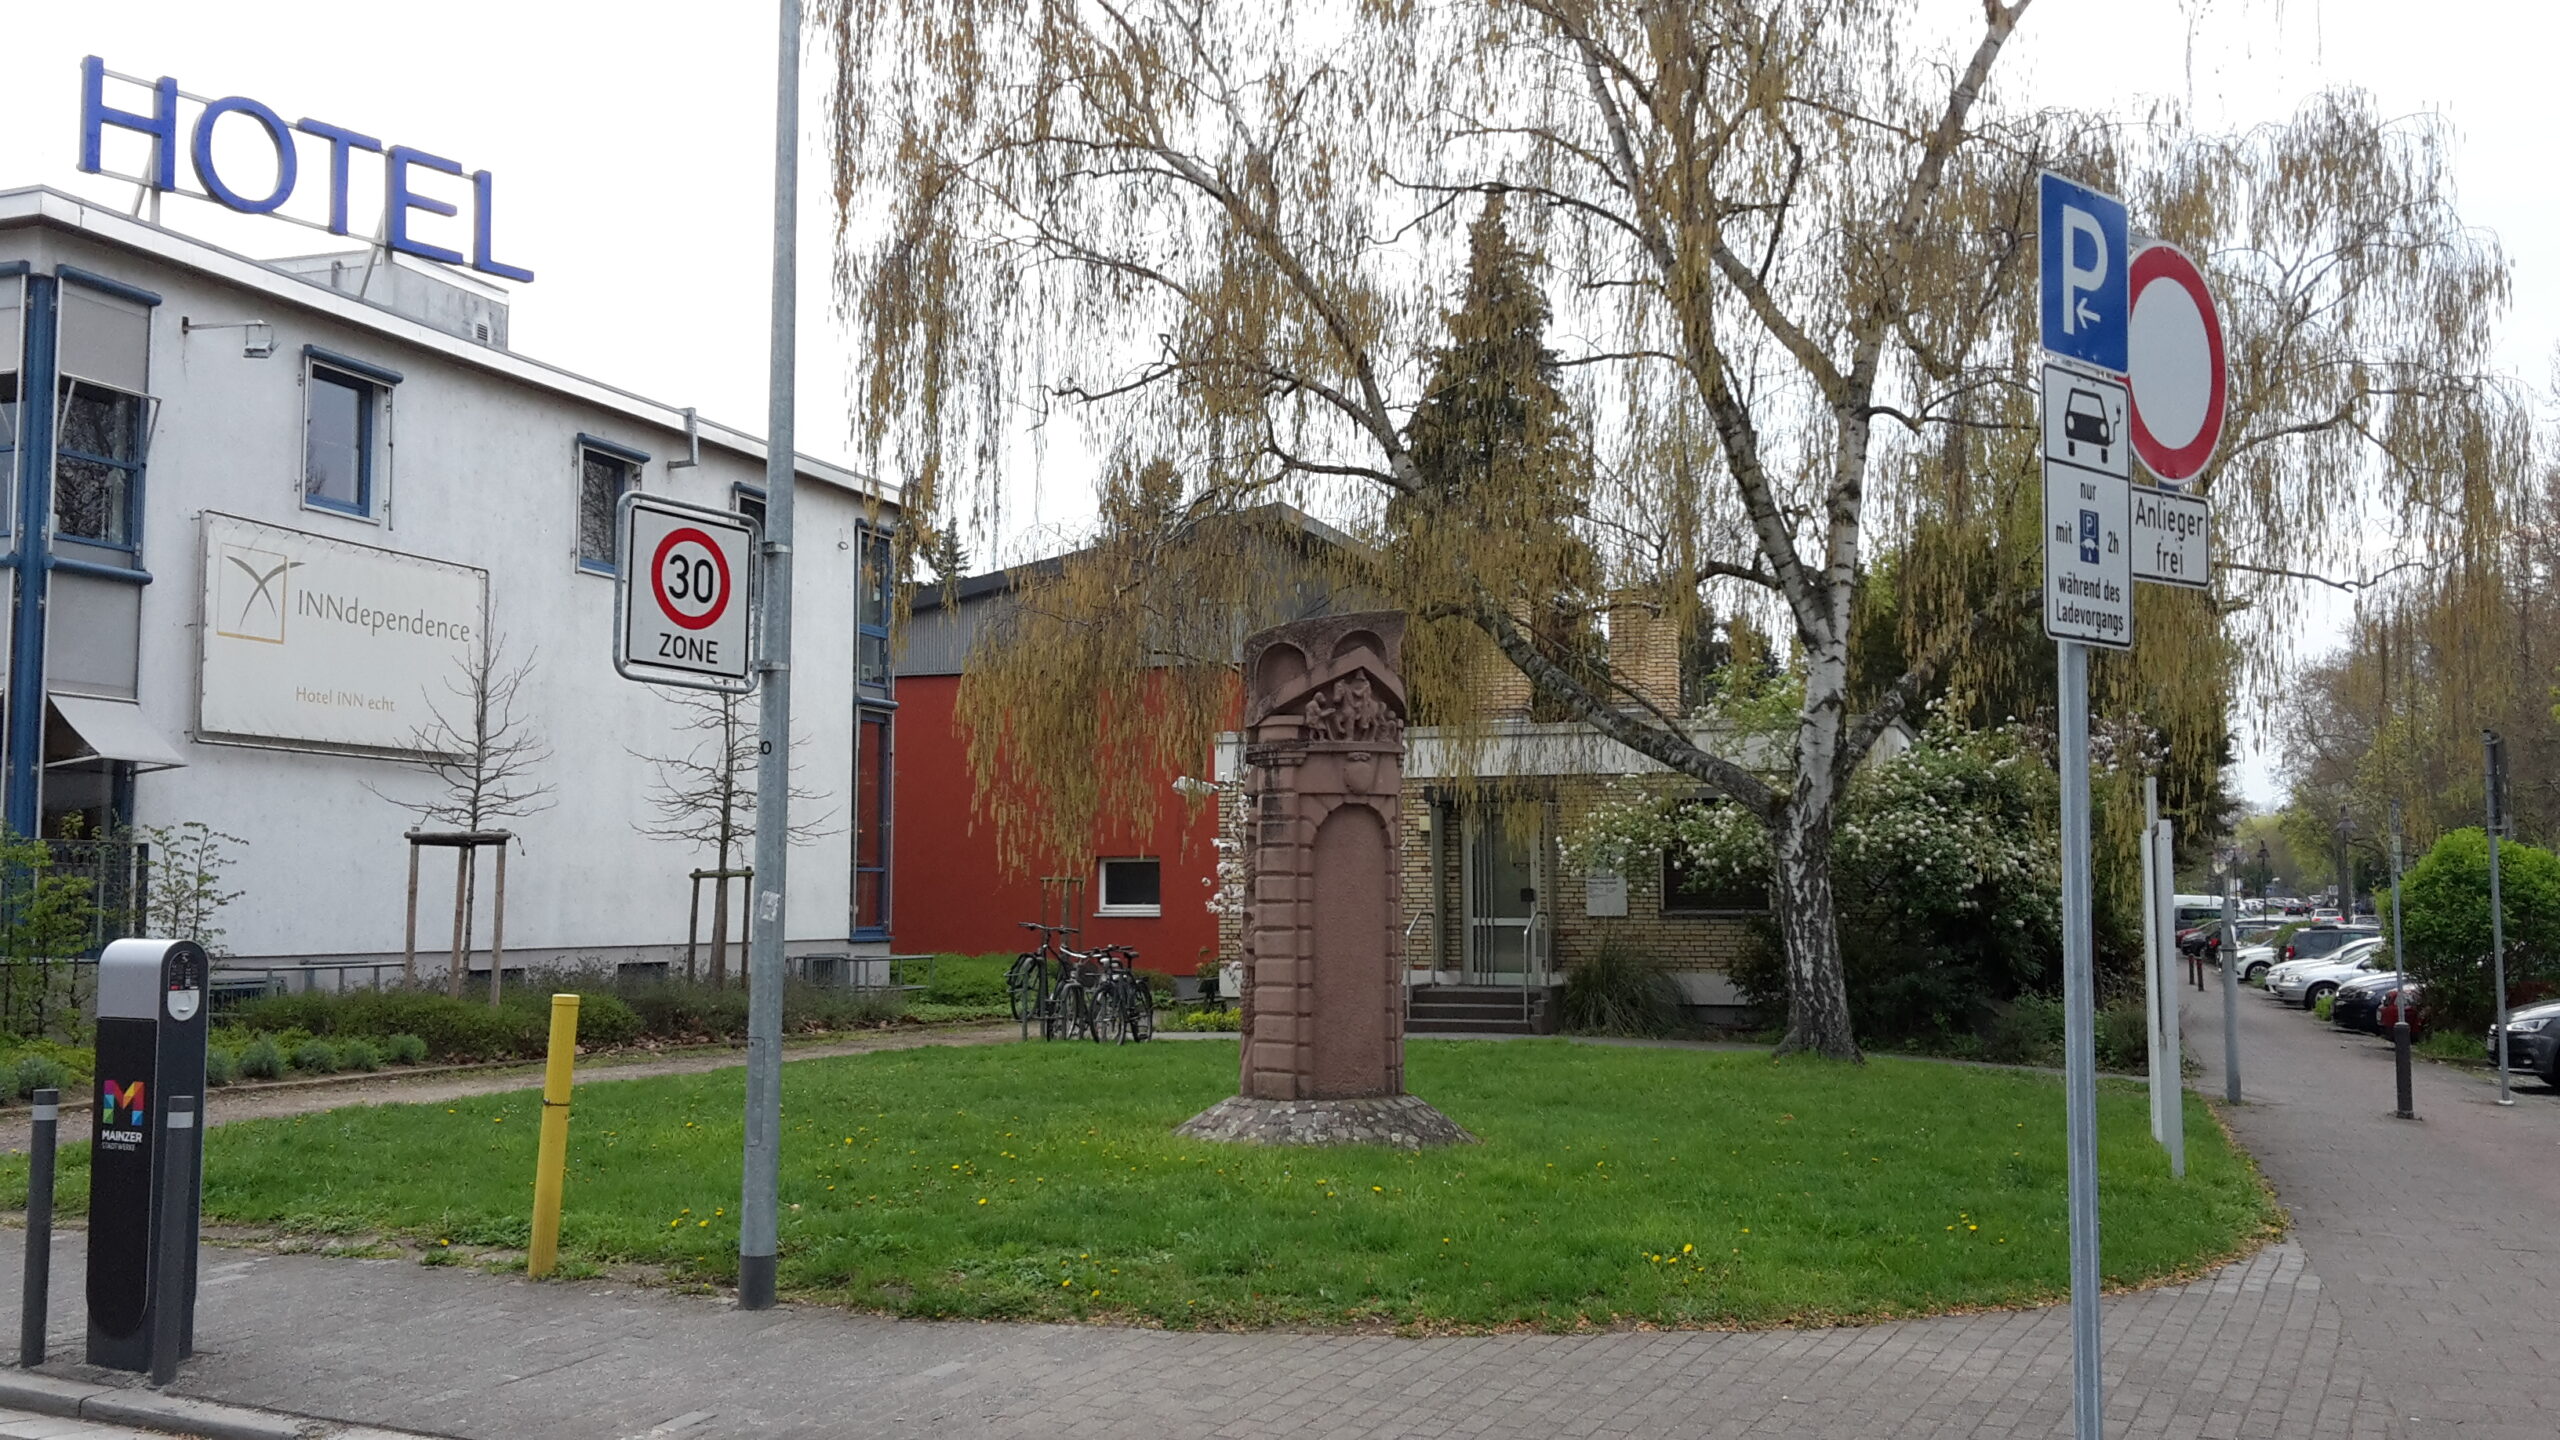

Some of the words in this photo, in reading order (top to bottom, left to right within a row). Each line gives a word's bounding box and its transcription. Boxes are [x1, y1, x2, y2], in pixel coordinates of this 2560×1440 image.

[79, 54, 534, 283] HOTEL
[2062, 203, 2109, 336] P
[2079, 482, 2097, 500] nur
[2136, 497, 2204, 541] Anlieger
[2055, 521, 2073, 544] mit
[2107, 530, 2120, 555] 2h
[2156, 542, 2183, 575] frei
[668, 554, 714, 604] 30
[2058, 571, 2101, 601] während
[2103, 579, 2121, 604] des
[299, 589, 470, 642] INNdependence
[2056, 598, 2124, 636] Ladevorgangs
[658, 633, 719, 665] ZONE
[296, 686, 333, 705] Hotel
[367, 695, 395, 712] echt
[102, 1130, 142, 1143] MAINZER
